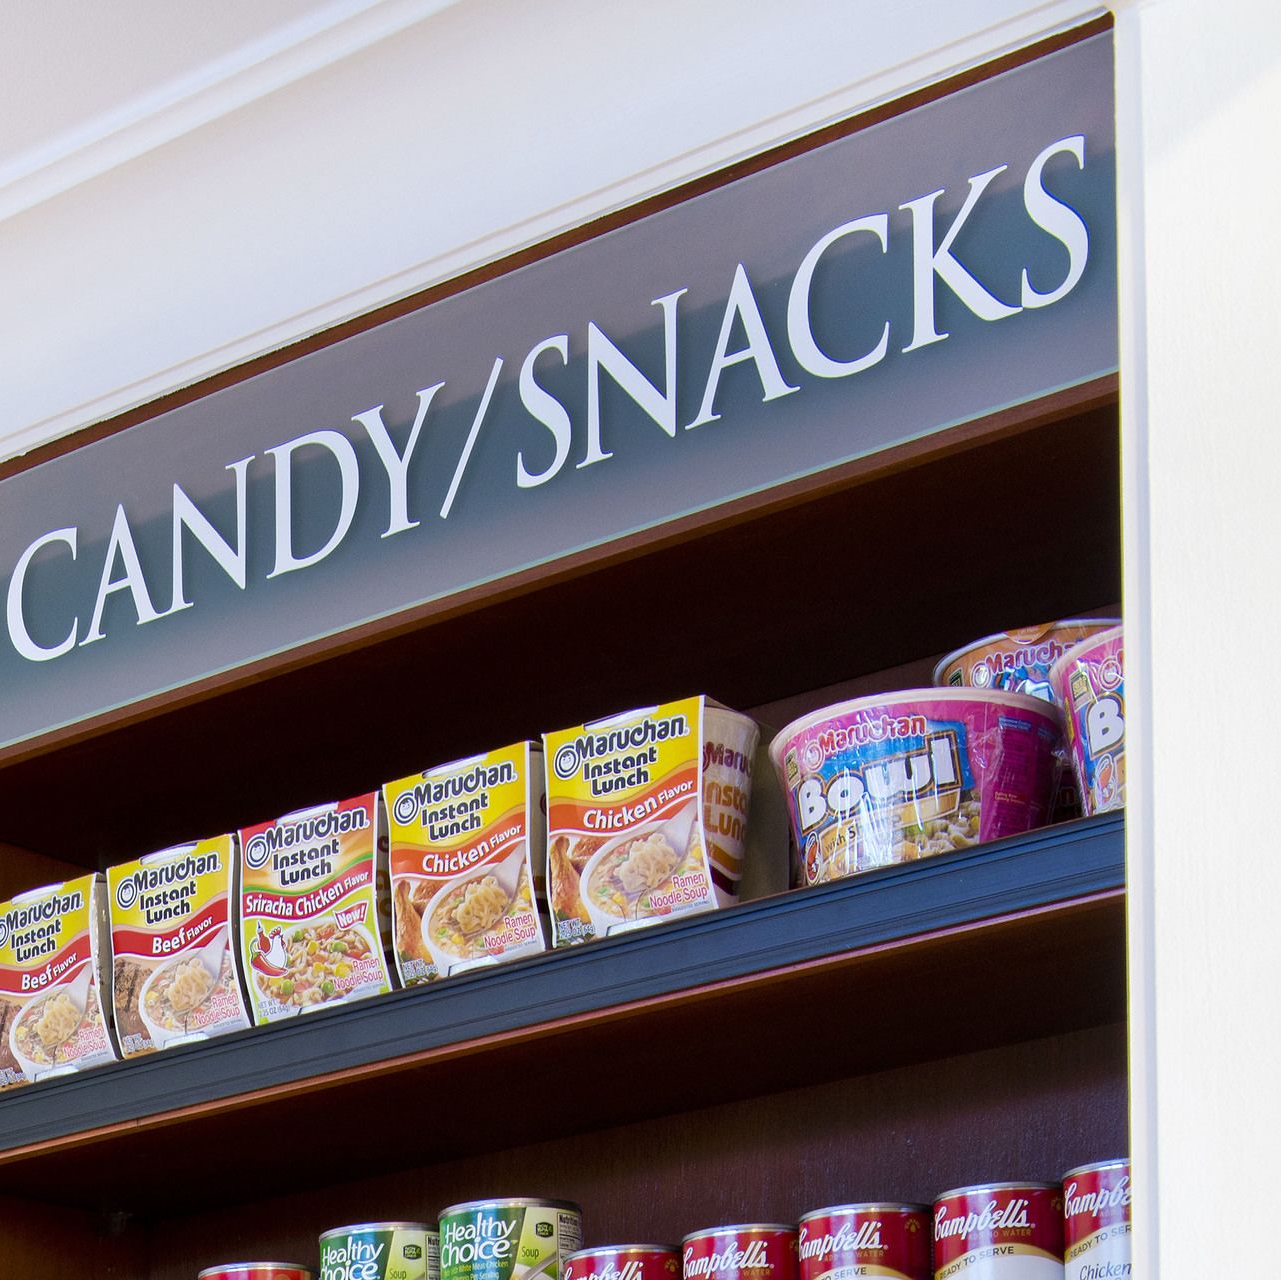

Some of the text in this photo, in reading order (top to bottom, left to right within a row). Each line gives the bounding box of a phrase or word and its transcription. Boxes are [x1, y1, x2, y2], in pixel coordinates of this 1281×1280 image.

[5, 135, 1090, 665] CANDY/SNACKS
[576, 715, 685, 759] Maruchan
[583, 747, 657, 780] Instant
[414, 762, 513, 805] Maruchan
[591, 769, 649, 796] Lunch
[421, 792, 488, 826] Instant
[266, 807, 365, 848] Maruchan
[429, 815, 481, 841] Lunch
[246, 872, 368, 916] Sriracha Chicken Flavor
[672, 871, 705, 888] Ramen
[650, 885, 707, 910] Noodle Soup
[337, 904, 365, 926] New!
[152, 916, 213, 954] Beef Flavor
[20, 951, 78, 991] Beef Flavor
[446, 1213, 516, 1243] Healthy
[935, 1199, 1028, 1242] Campbell's
[323, 1237, 385, 1265] Healthy
[442, 1236, 511, 1269] Choice
[800, 1221, 882, 1262] Campbell's
[939, 1246, 1014, 1280] READY TO SERVE
